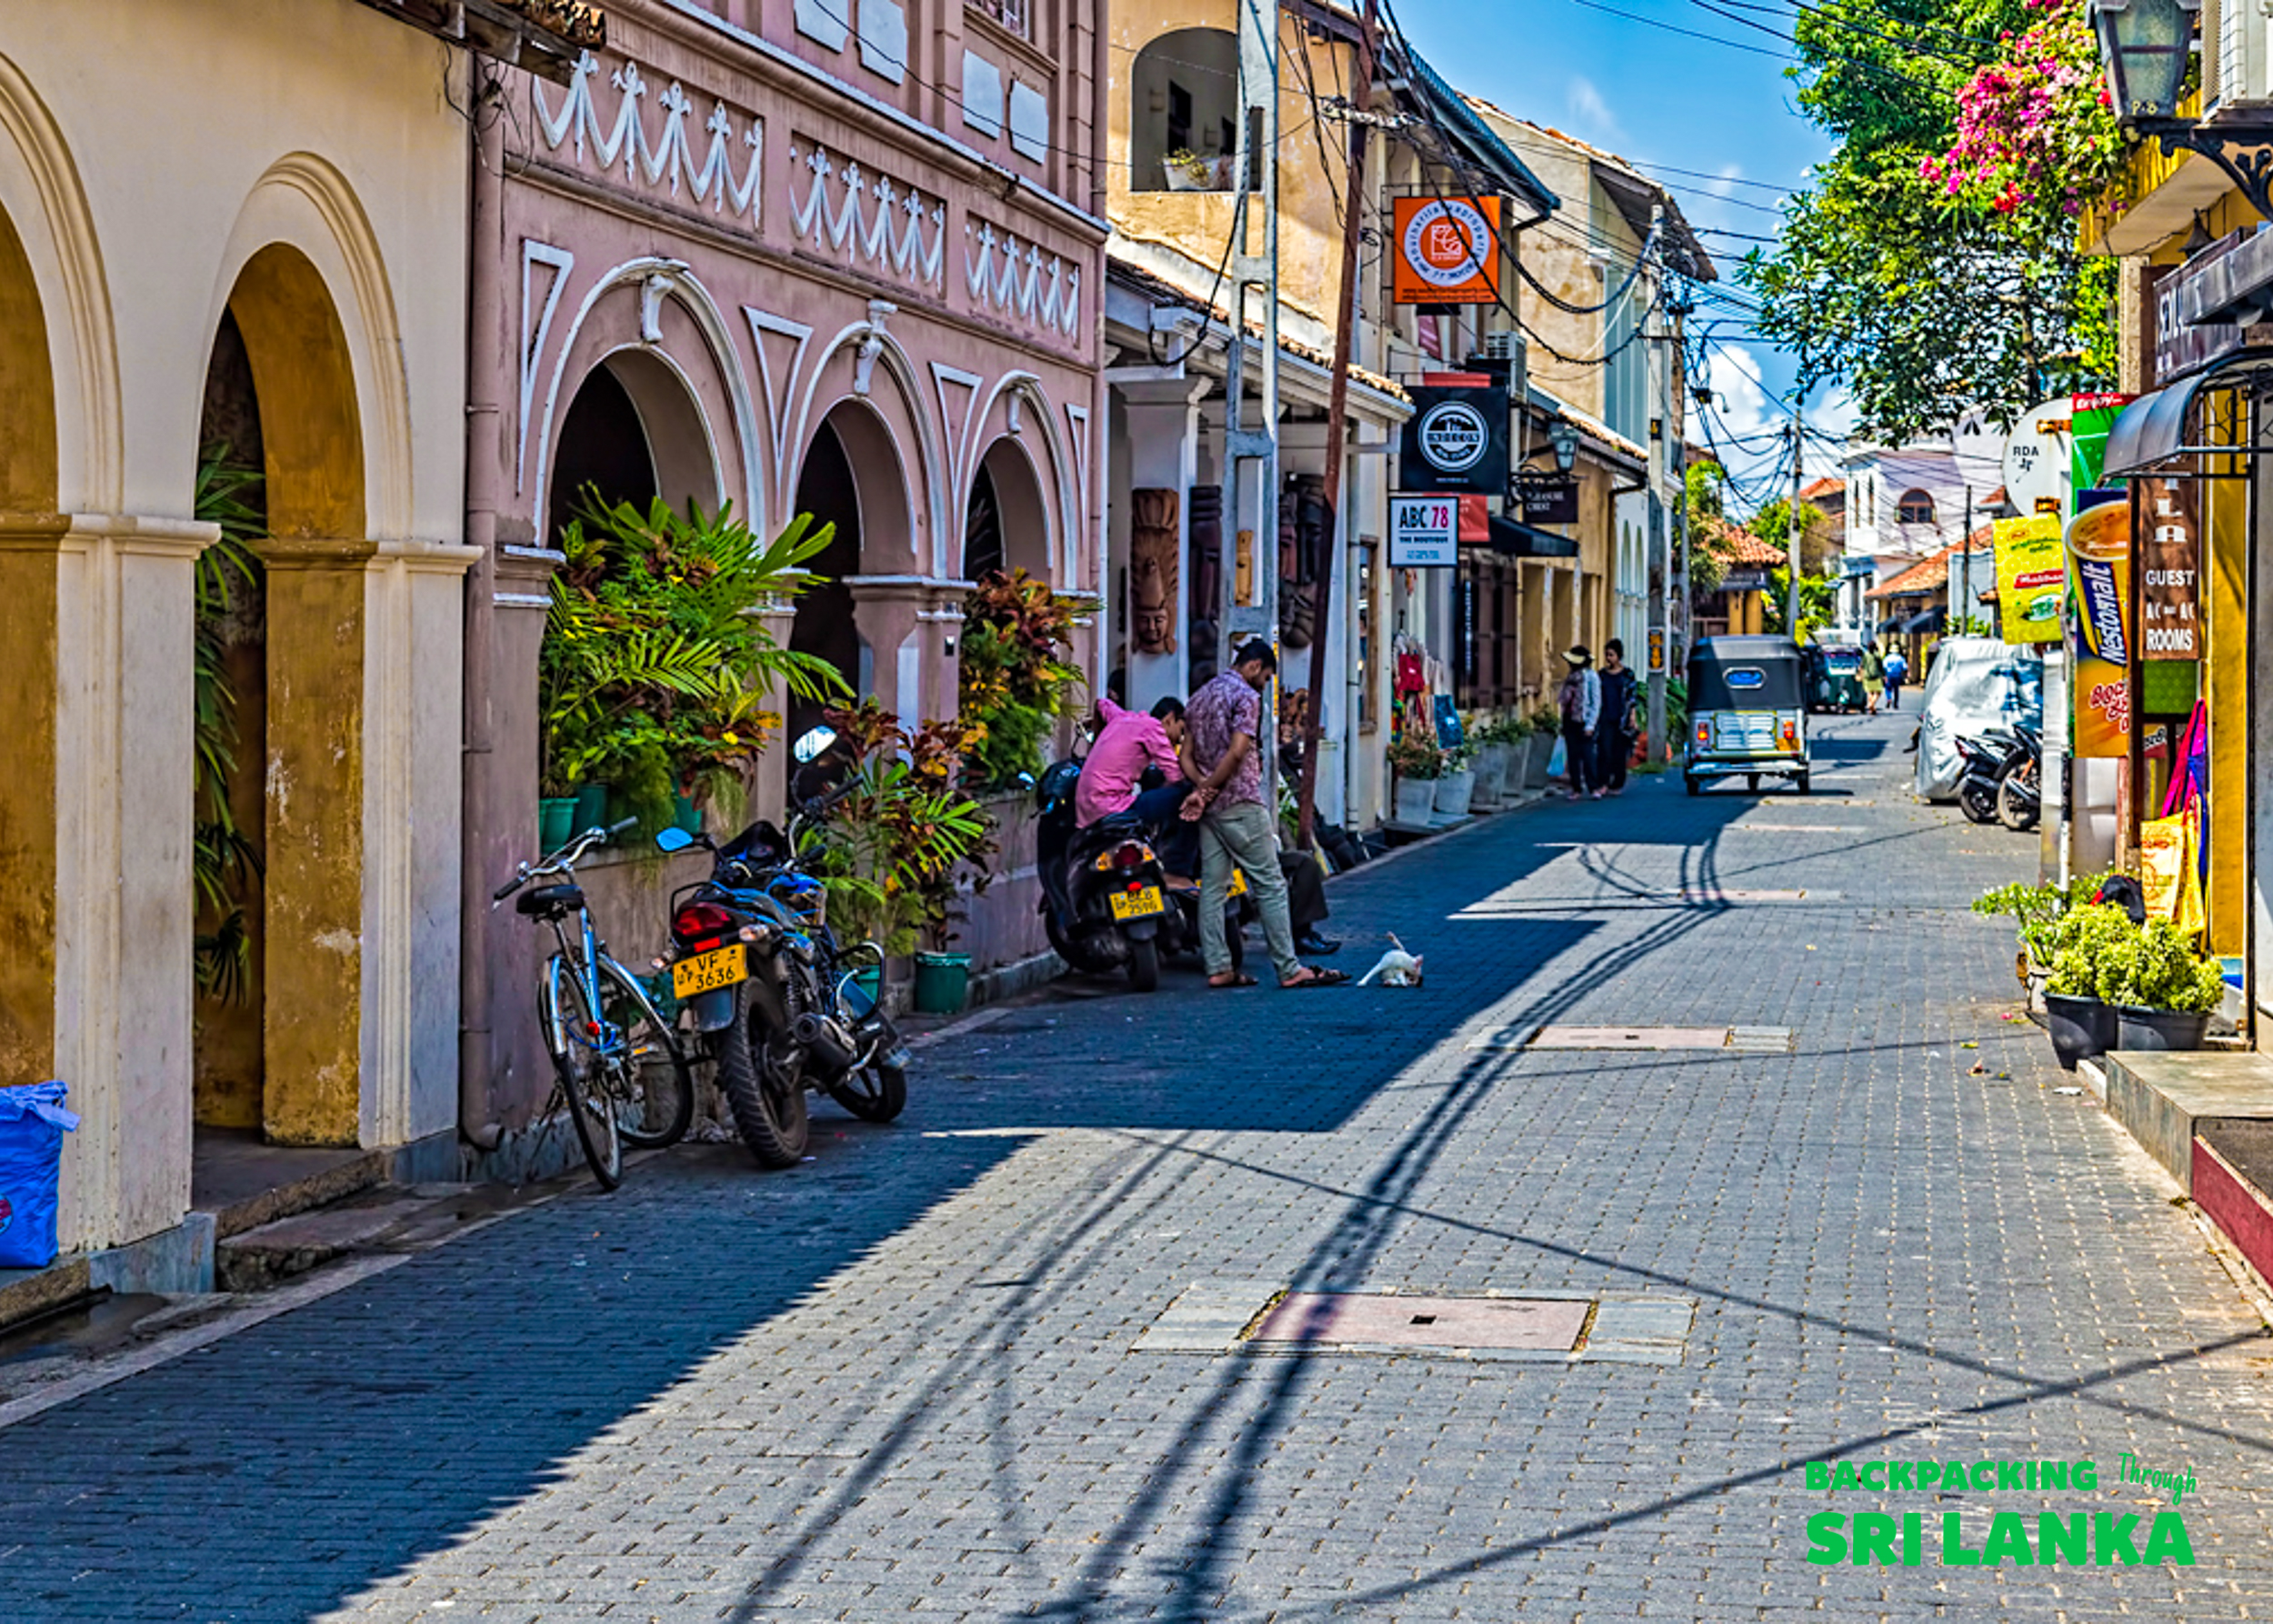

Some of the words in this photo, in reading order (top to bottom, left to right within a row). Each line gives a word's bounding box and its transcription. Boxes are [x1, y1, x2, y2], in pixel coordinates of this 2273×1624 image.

[2013, 446, 2039, 456] RDA
[1399, 506, 1427, 528] ABC
[1431, 506, 1448, 528] 78
[2146, 569, 2195, 586] GUEST
[2082, 562, 2128, 665] Nestomalt
[2147, 628, 2193, 650] ROOMS
[696, 950, 718, 972] VF
[696, 965, 736, 991] 3636
